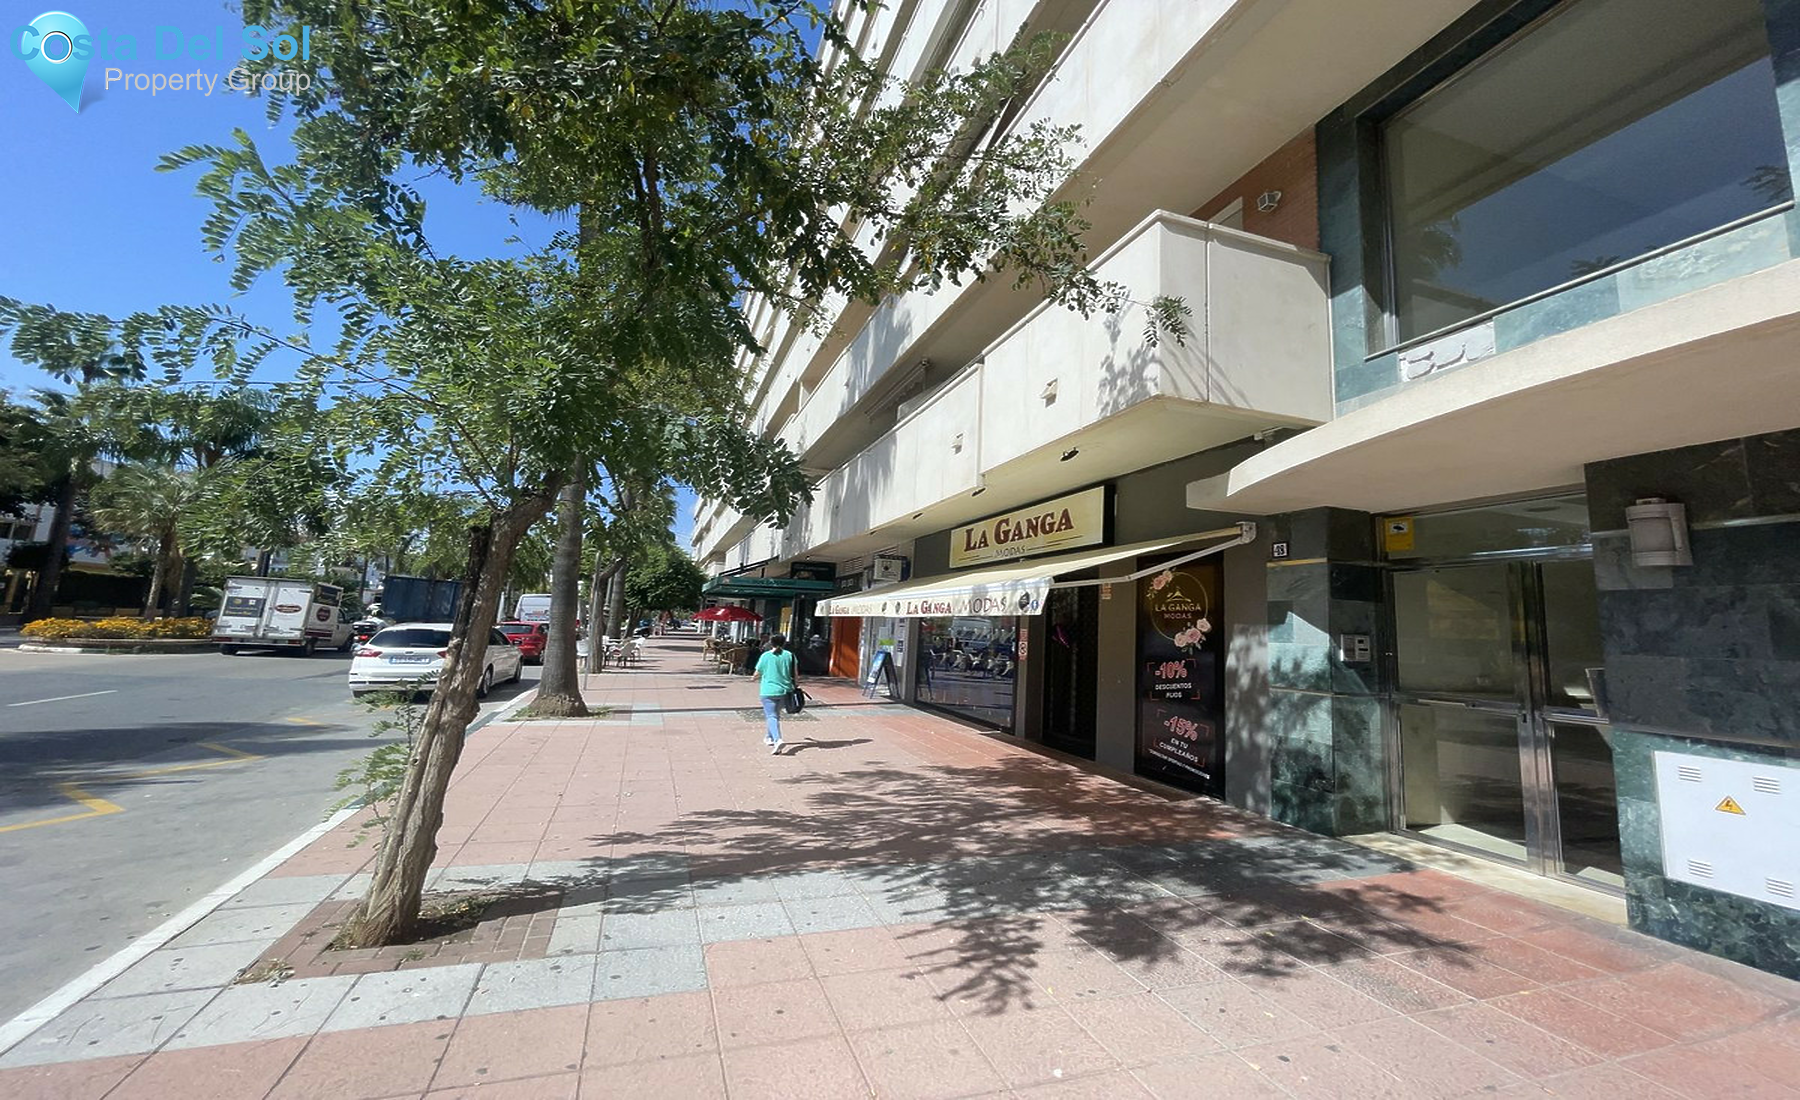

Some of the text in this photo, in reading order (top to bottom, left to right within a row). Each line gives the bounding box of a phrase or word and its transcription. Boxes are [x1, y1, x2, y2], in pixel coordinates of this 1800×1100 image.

[964, 508, 1074, 552] LA GANGA
[993, 545, 1026, 558] MODAS
[906, 601, 918, 614] LA
[920, 600, 952, 614] GANGA
[1168, 603, 1201, 611] GANGA
[1154, 660, 1188, 679] -10%
[1163, 715, 1198, 741] -15%
